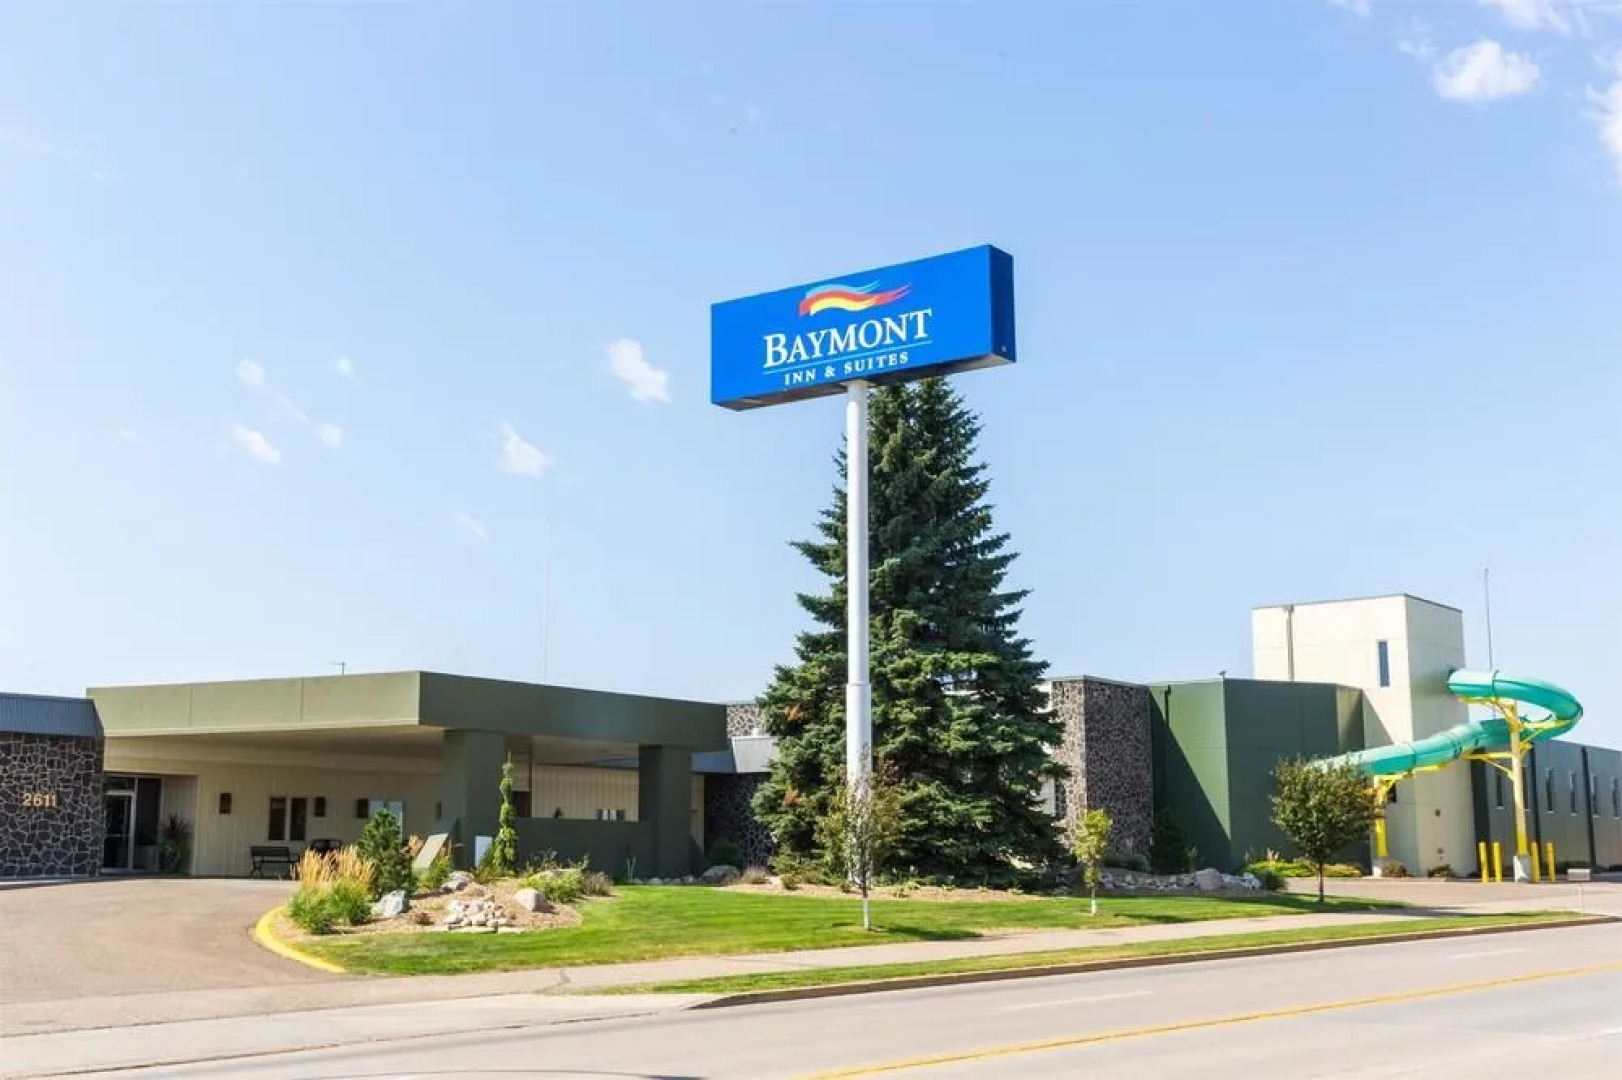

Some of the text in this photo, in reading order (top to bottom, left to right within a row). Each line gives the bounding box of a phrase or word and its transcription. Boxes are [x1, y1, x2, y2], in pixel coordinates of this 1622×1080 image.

[763, 308, 932, 368] BAYMONT
[784, 351, 909, 385] INN & SUITES
[22, 792, 57, 807] 2611
